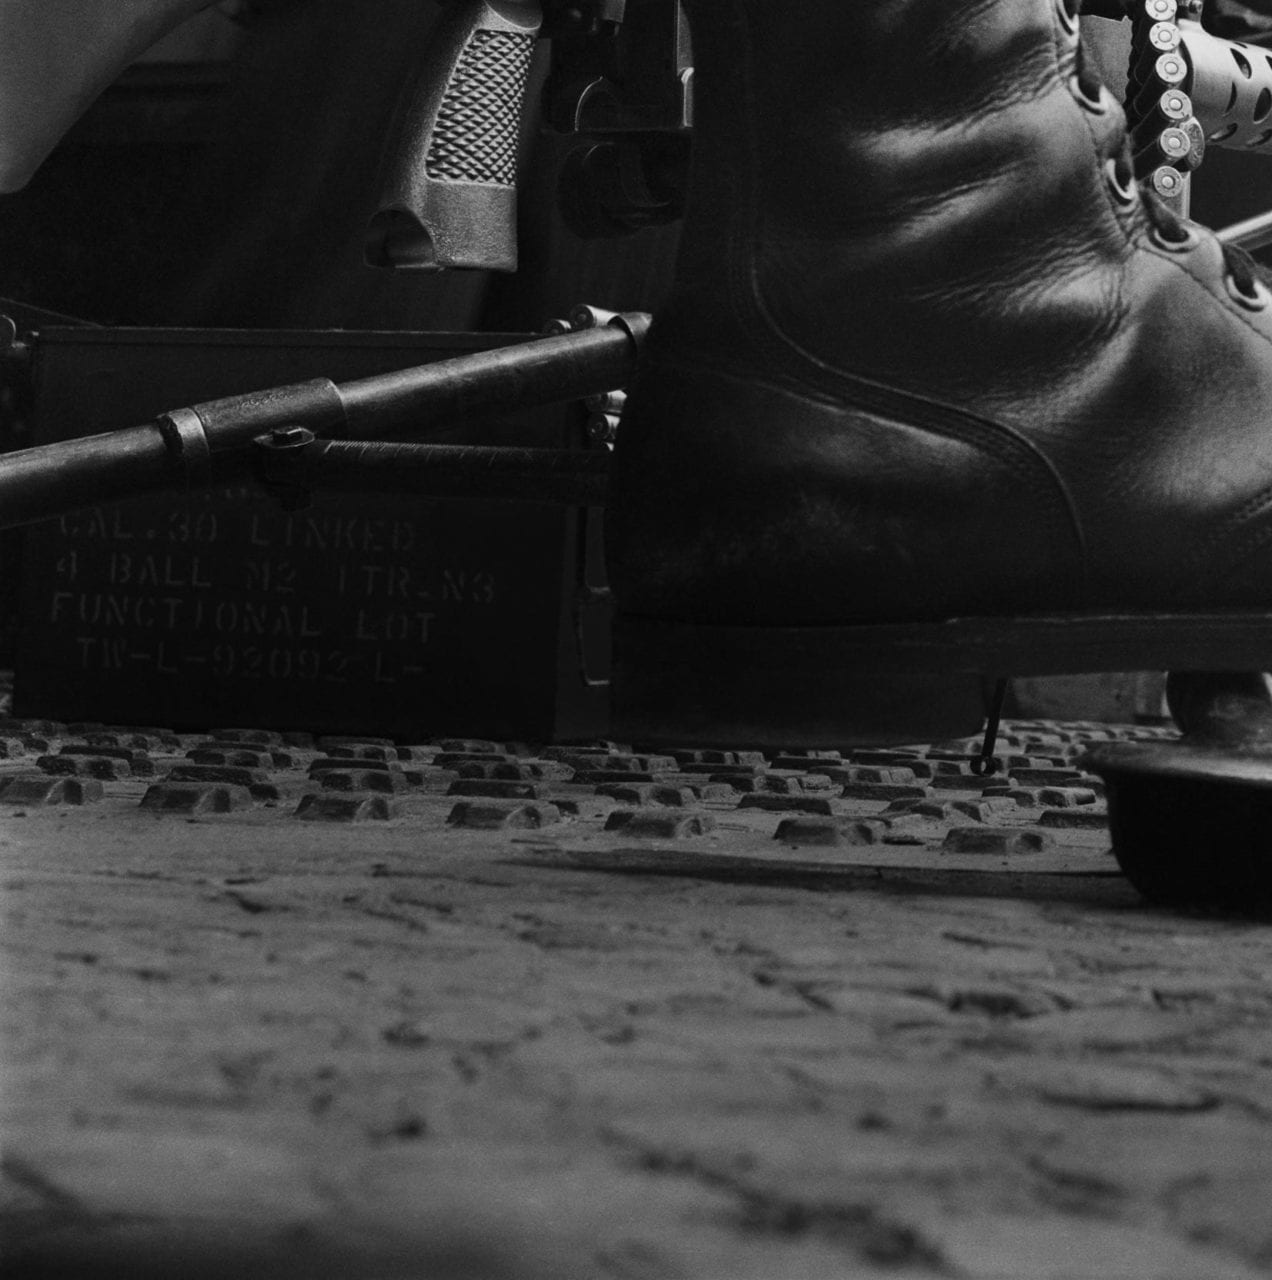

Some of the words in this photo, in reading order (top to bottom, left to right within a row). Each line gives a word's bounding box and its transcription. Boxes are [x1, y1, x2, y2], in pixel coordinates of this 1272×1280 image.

[251, 513, 416, 551] LINKED
[110, 551, 213, 588] BALL
[50, 592, 323, 638] FUNCTIONAL
[355, 610, 438, 644] LOT
